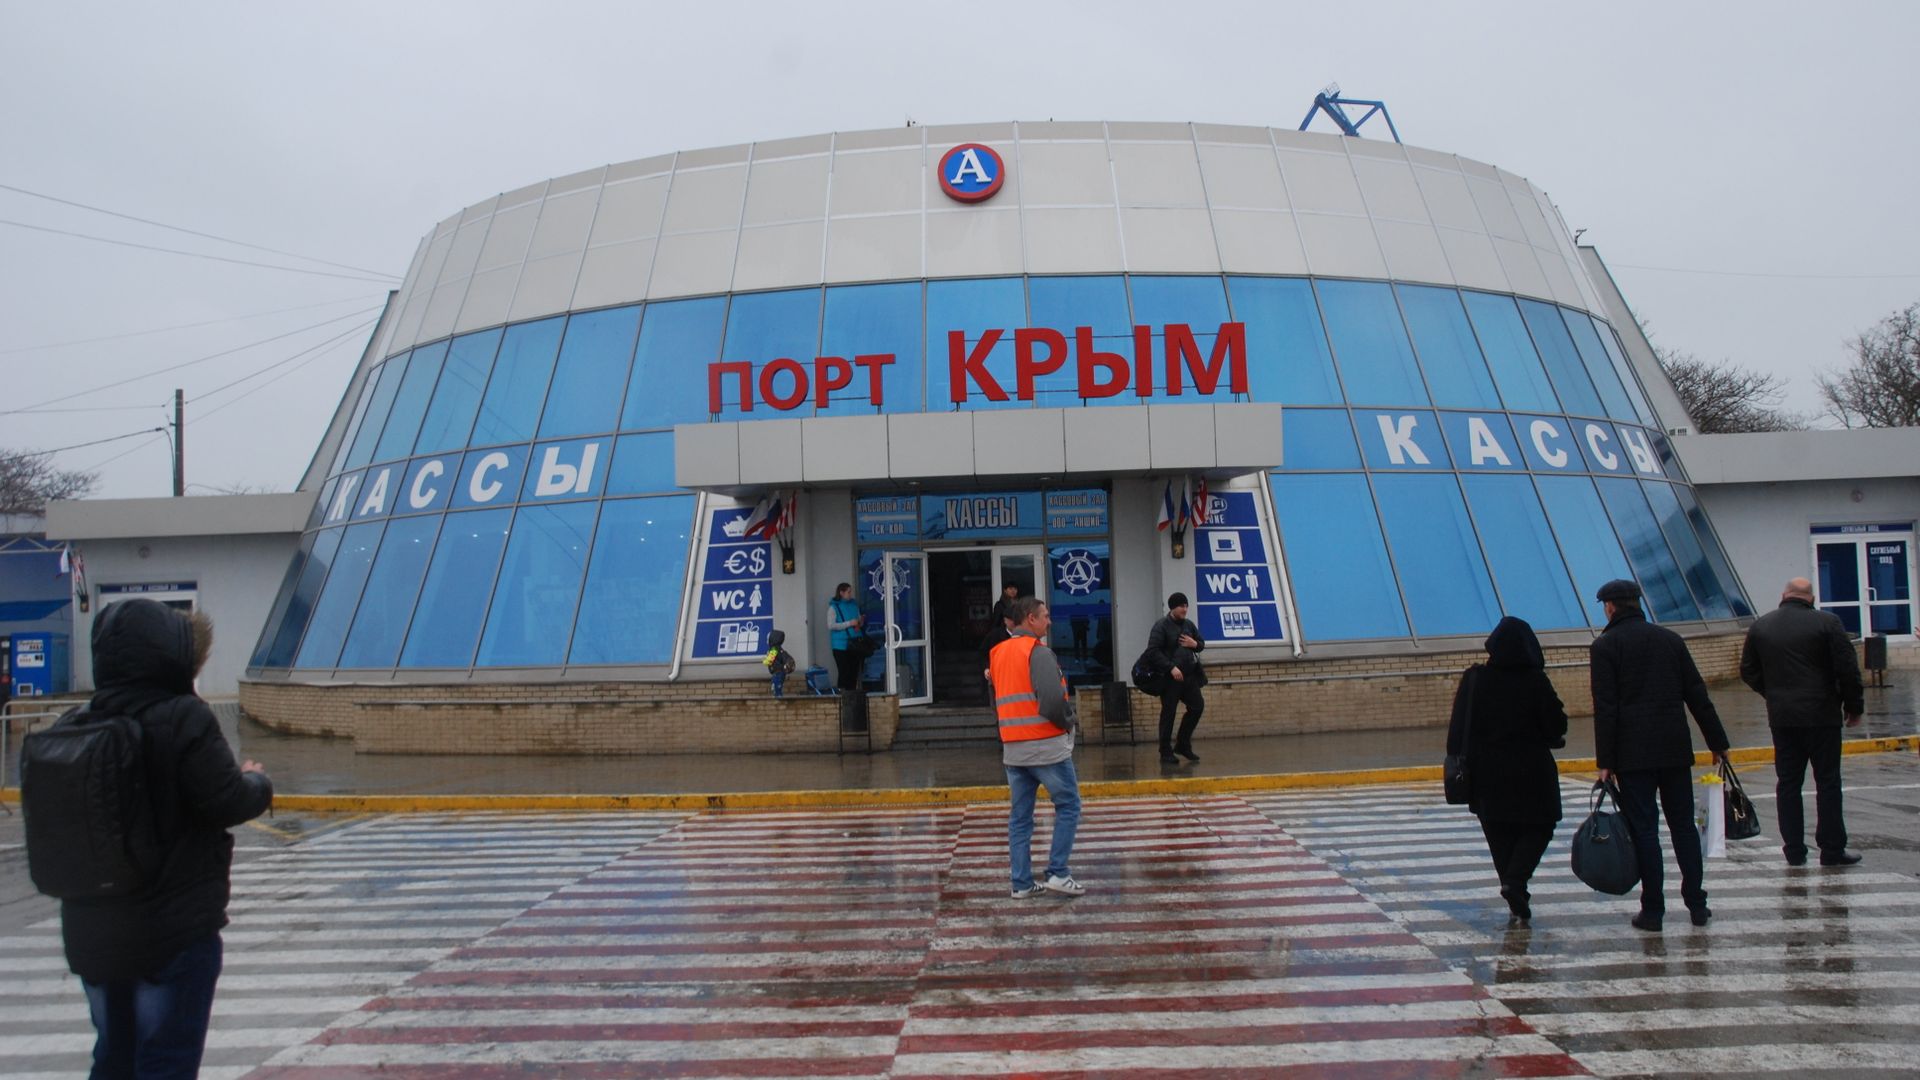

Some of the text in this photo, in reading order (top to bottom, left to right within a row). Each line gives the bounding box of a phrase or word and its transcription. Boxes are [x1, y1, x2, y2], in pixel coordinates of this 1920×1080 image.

[707, 322, 1249, 413] ПОРТ КРЫМ
[1376, 415, 1660, 474] КАССЫ
[329, 443, 599, 521] КАССЫ
[945, 497, 1017, 529] КАССЫ
[712, 589, 745, 611] WC
[1205, 573, 1242, 594] WC
